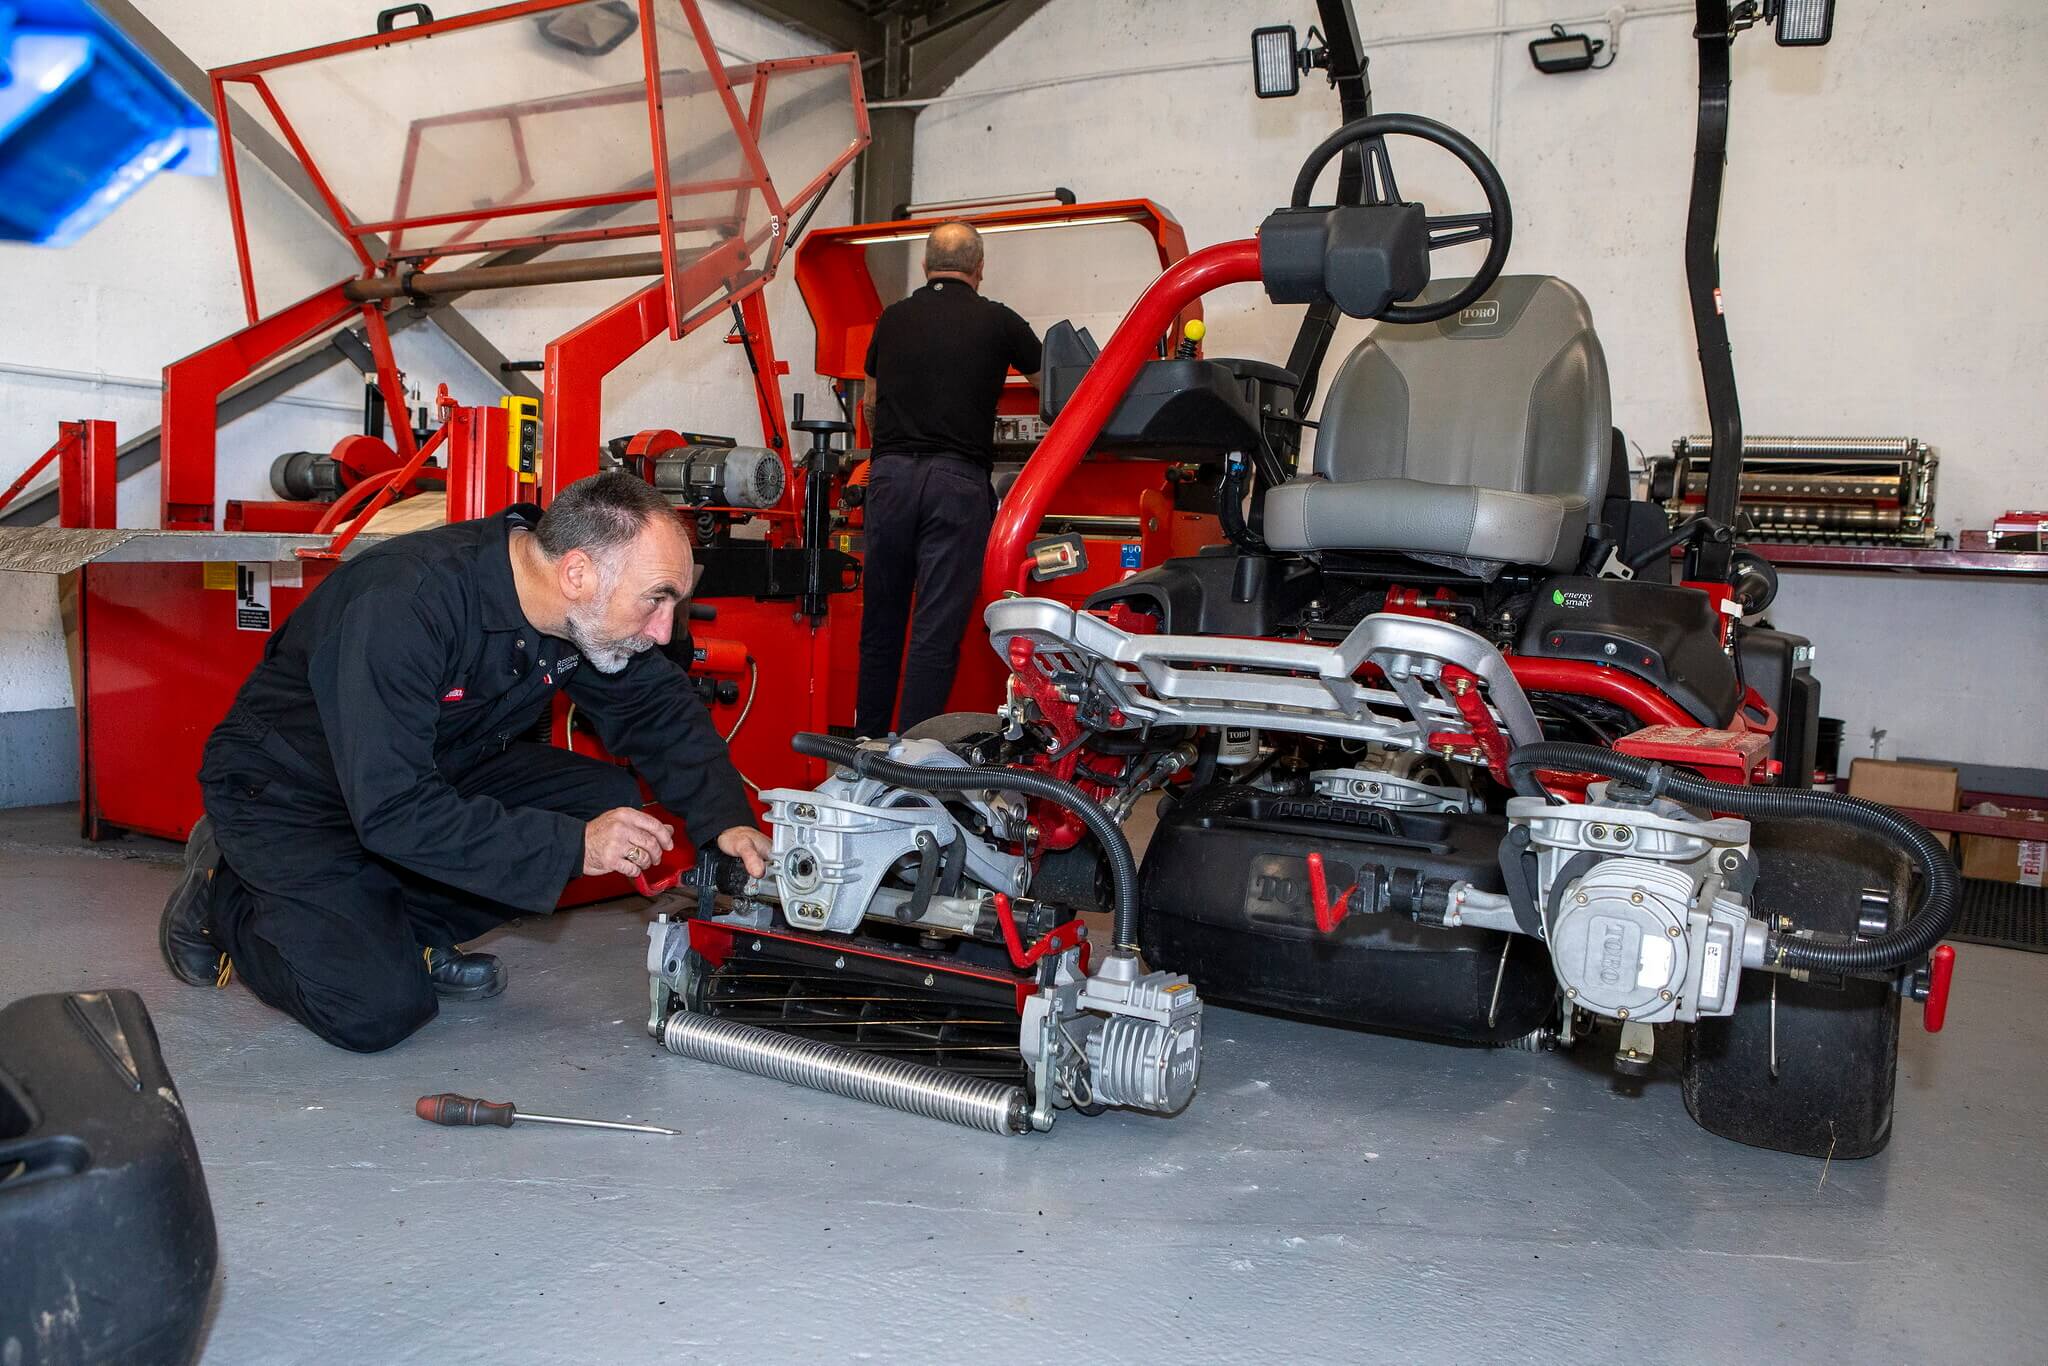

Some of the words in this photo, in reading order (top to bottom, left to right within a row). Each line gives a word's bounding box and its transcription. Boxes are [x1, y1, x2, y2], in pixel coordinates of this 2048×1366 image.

[771, 215, 779, 237] ED2
[1463, 308, 1496, 319] TORO
[1564, 592, 1592, 601] energy
[1229, 731, 1249, 739] TORO
[1600, 923, 1625, 985] TORO
